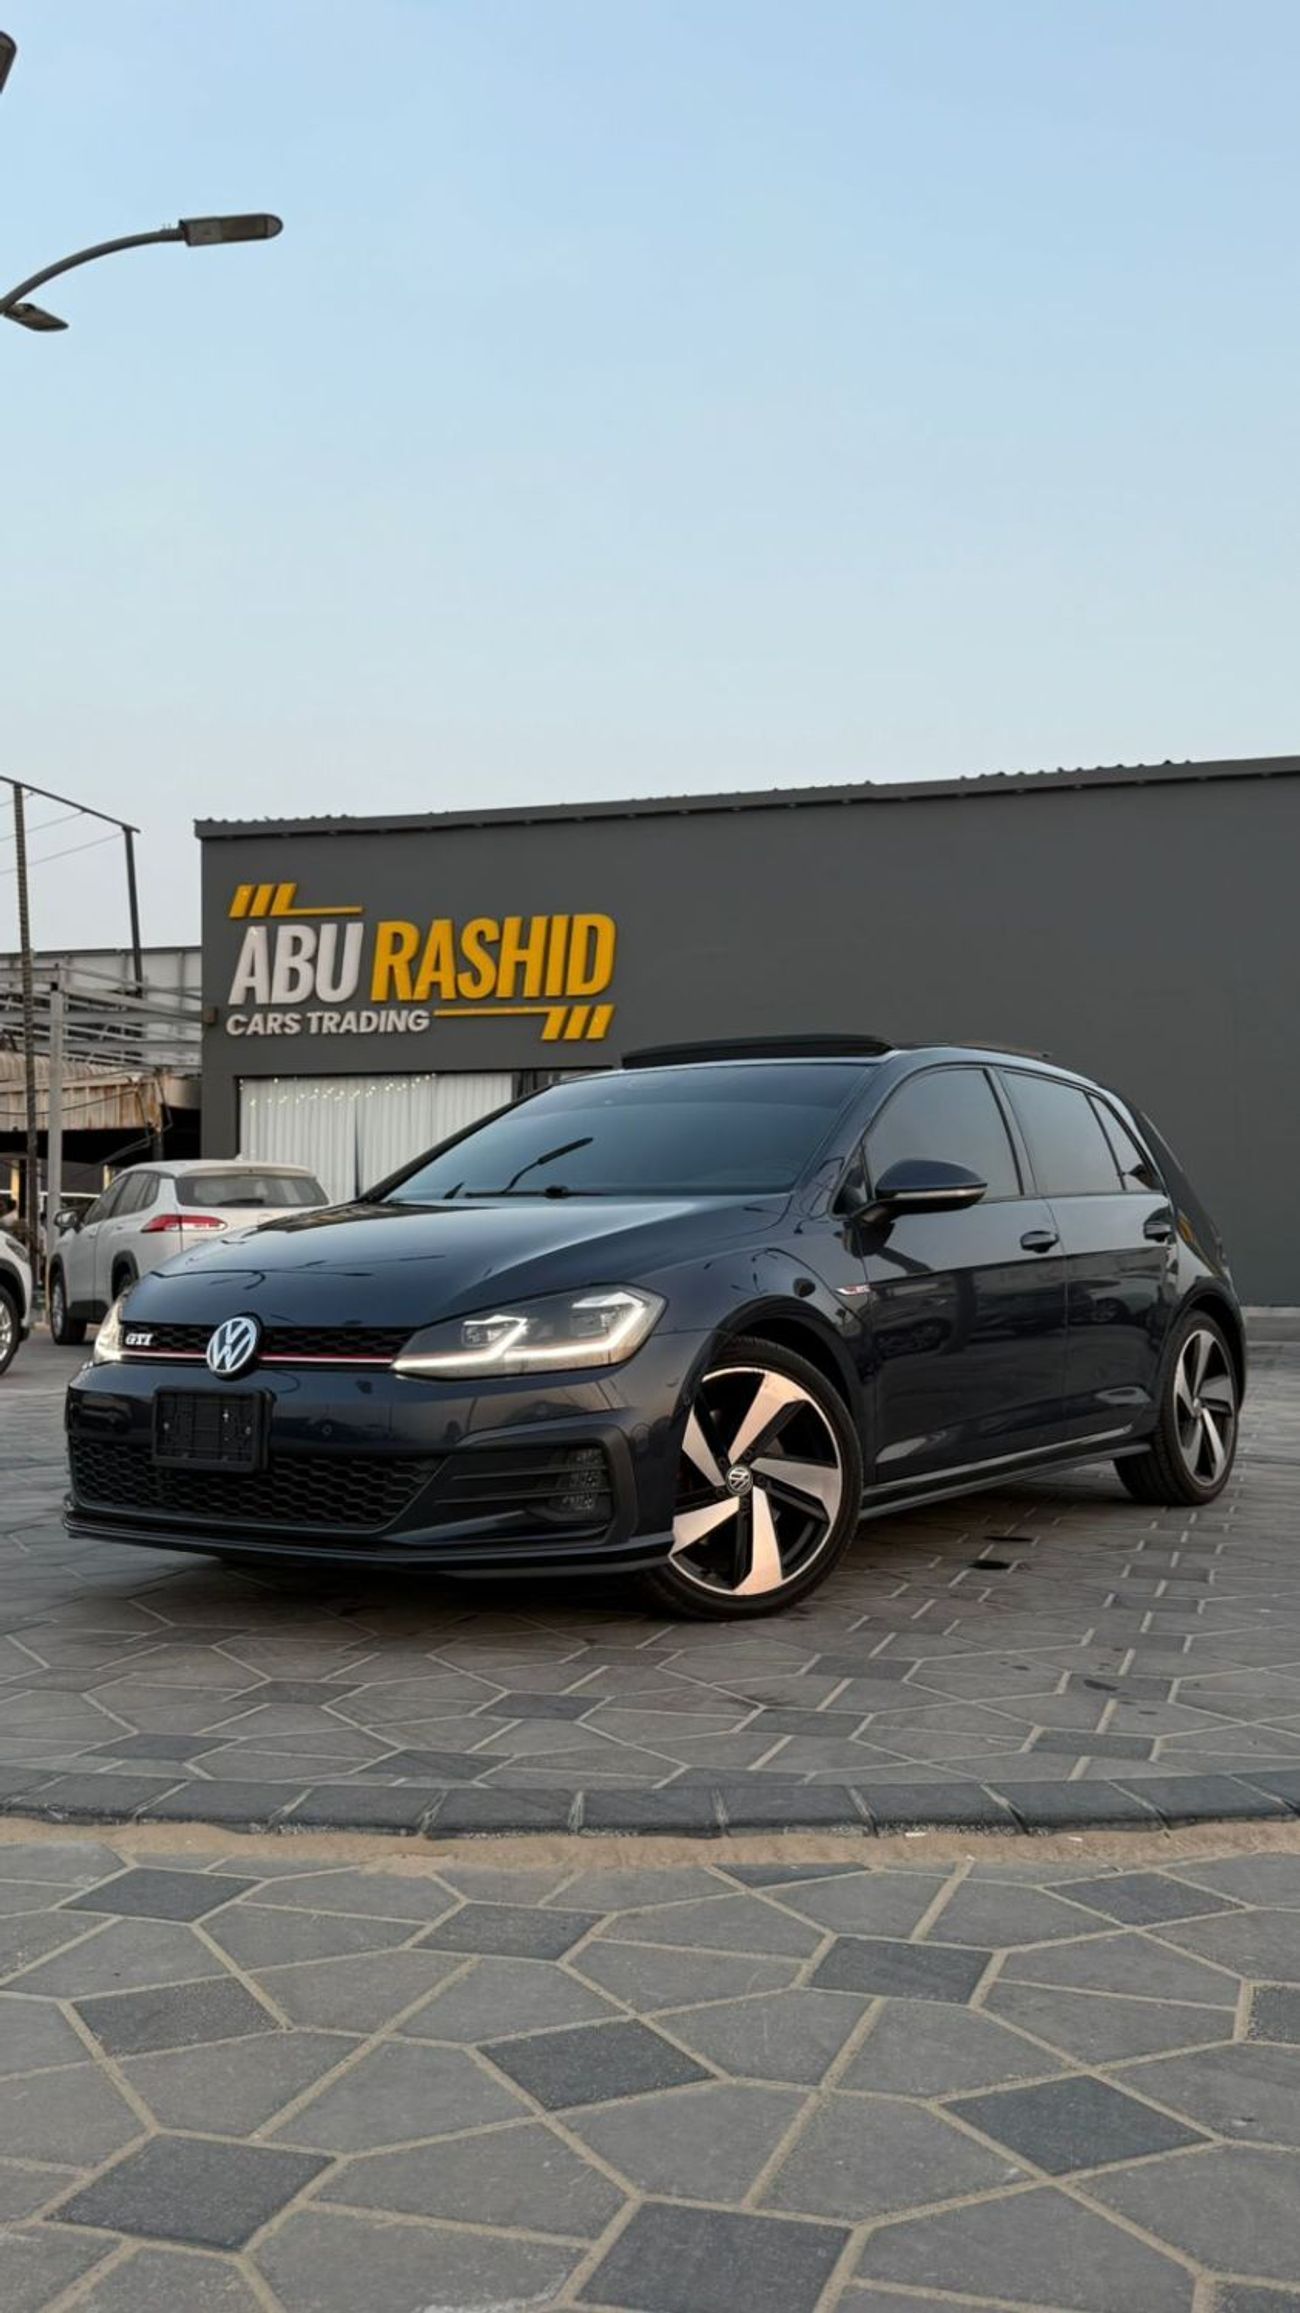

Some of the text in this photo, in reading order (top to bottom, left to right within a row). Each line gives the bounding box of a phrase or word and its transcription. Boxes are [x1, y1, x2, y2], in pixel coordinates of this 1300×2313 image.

[228, 914, 616, 1005] ABU RASHID
[226, 1010, 430, 1036] CARS TRADING
[125, 1333, 153, 1346] GTI
